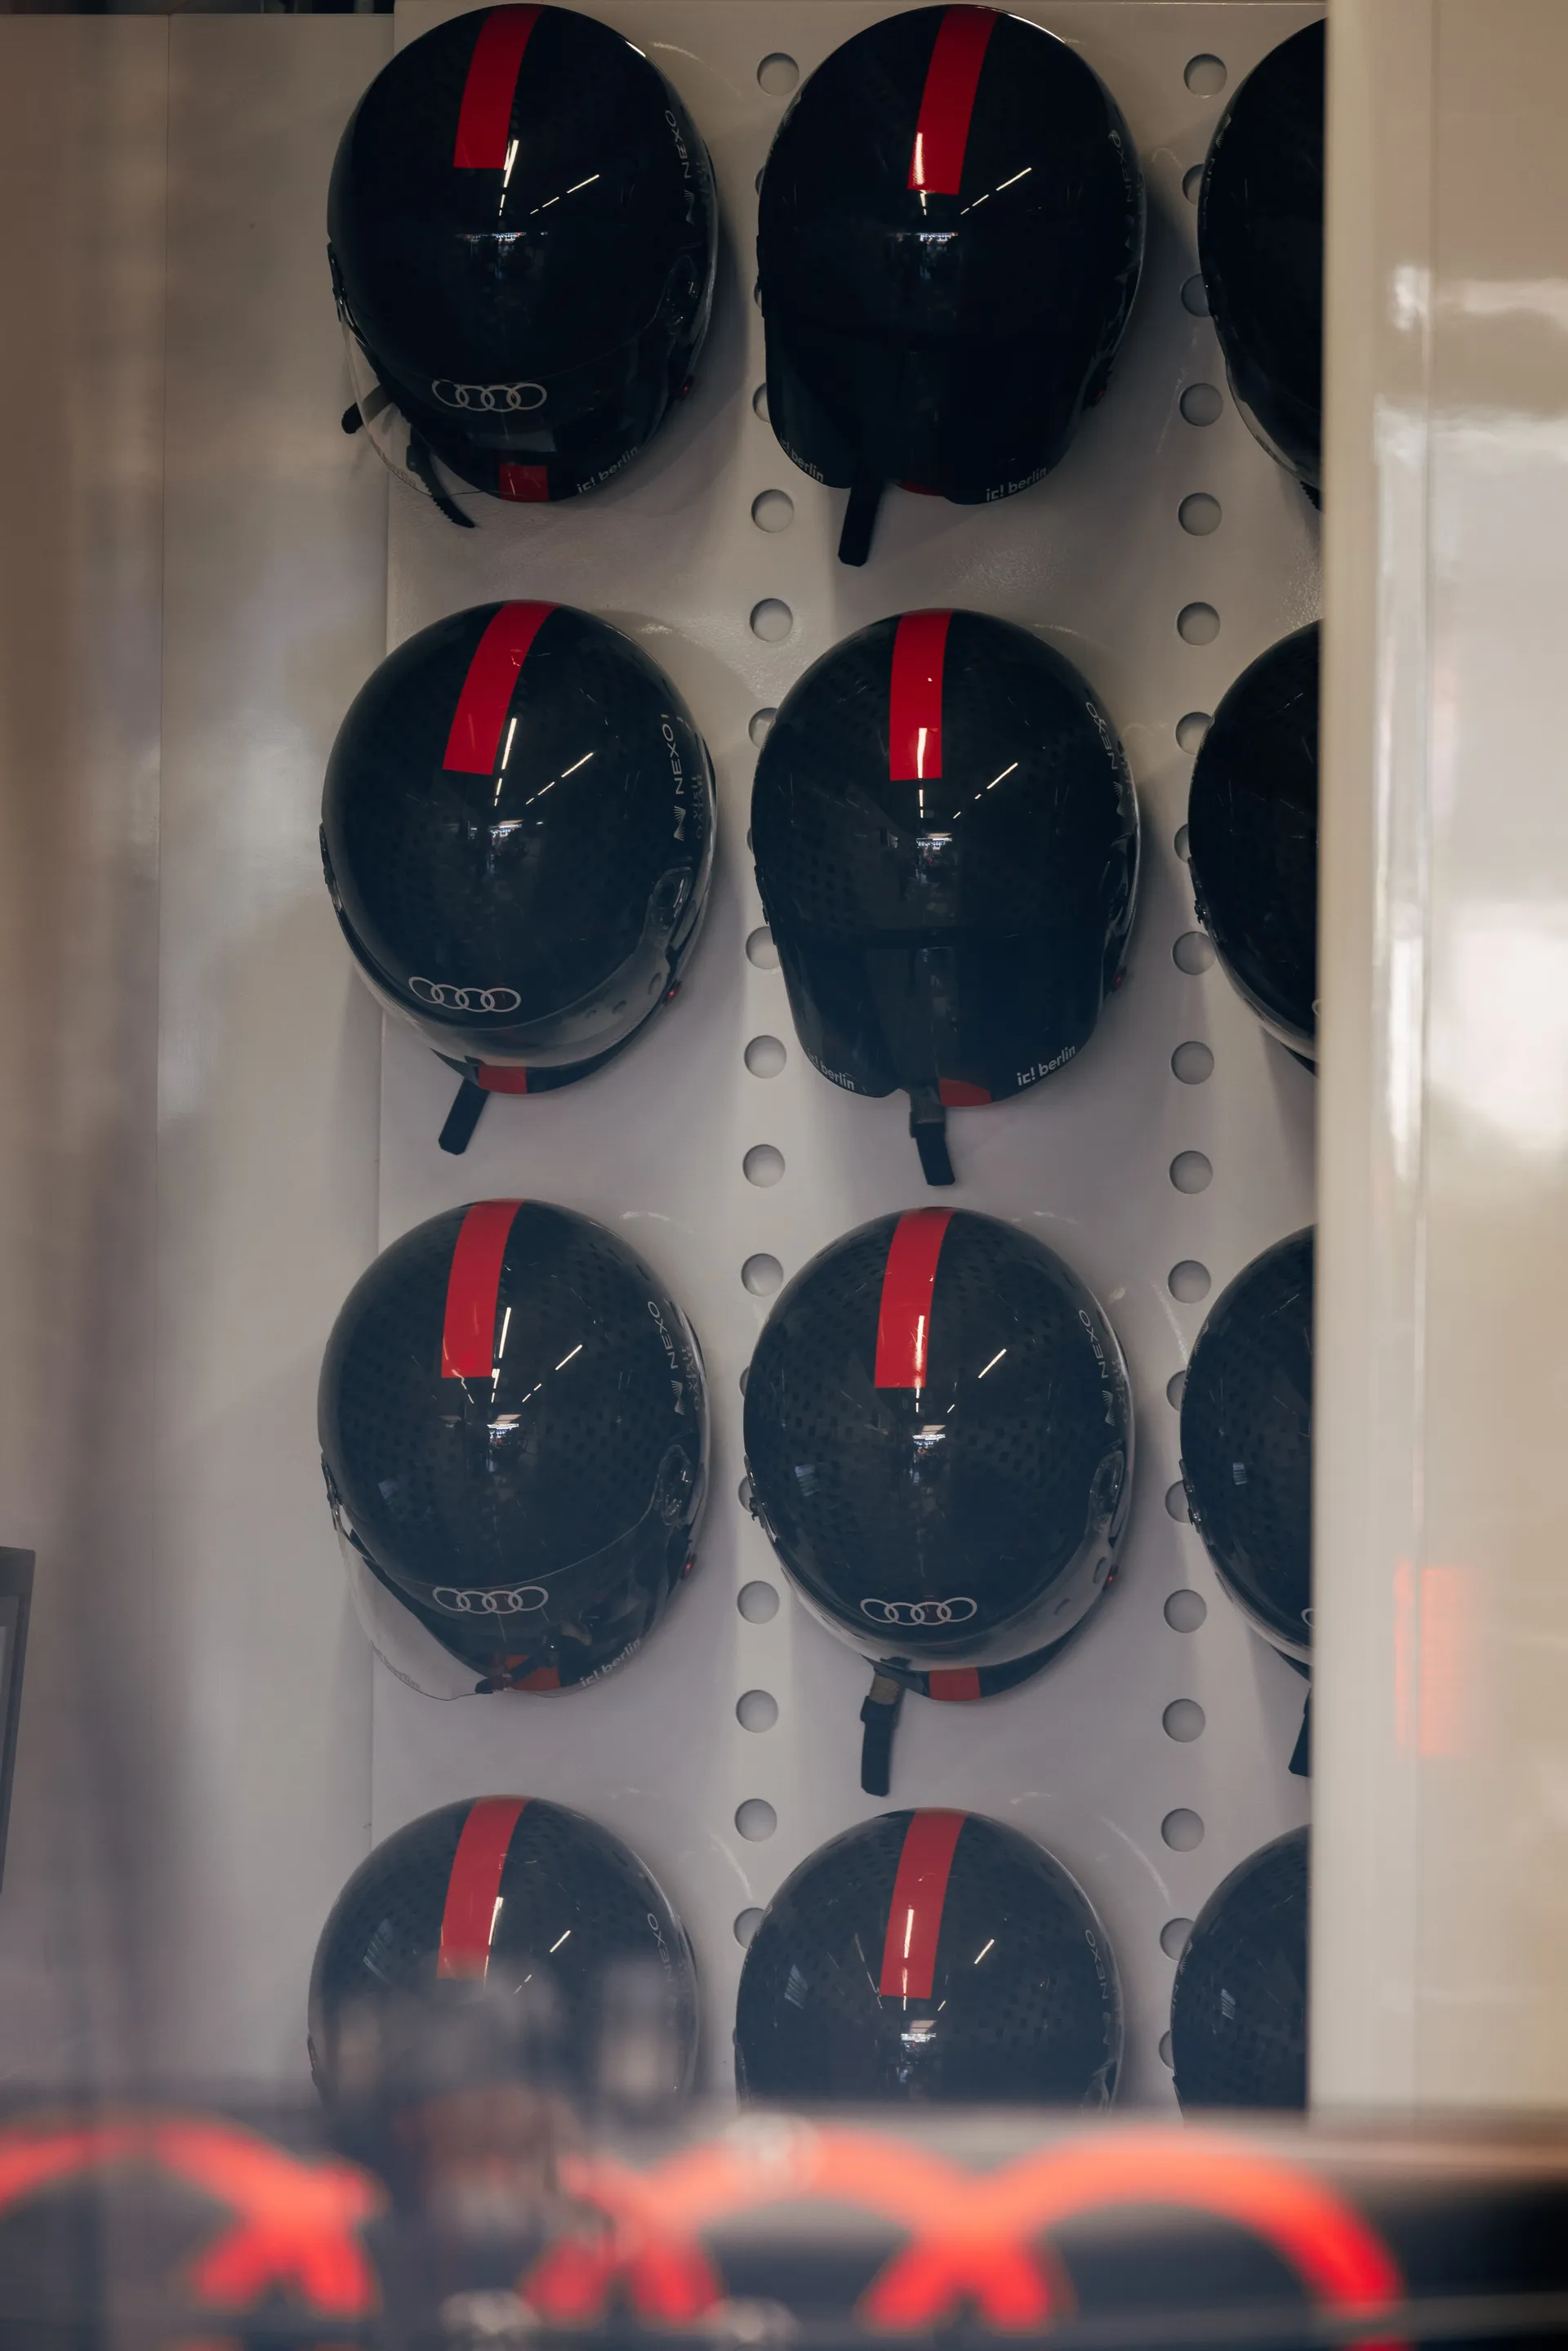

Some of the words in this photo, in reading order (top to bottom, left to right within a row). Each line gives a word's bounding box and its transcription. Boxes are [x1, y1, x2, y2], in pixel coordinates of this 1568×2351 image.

[665, 109, 693, 179] NEXO
[598, 446, 638, 481] berlin
[791, 448, 824, 483] berlin
[1008, 466, 1047, 494] berlin
[662, 723, 684, 795] NEXO
[1085, 702, 1119, 770] NEXO
[819, 1059, 855, 1091] berlin
[1017, 1067, 1036, 1086] ic!
[1038, 1046, 1076, 1077] berlin
[648, 1300, 679, 1369] NEXO
[1079, 1309, 1109, 1379] NEXO
[600, 1639, 640, 1673] berlin
[647, 1913, 674, 1983] NEXO
[1085, 1929, 1109, 2000] NEXO
